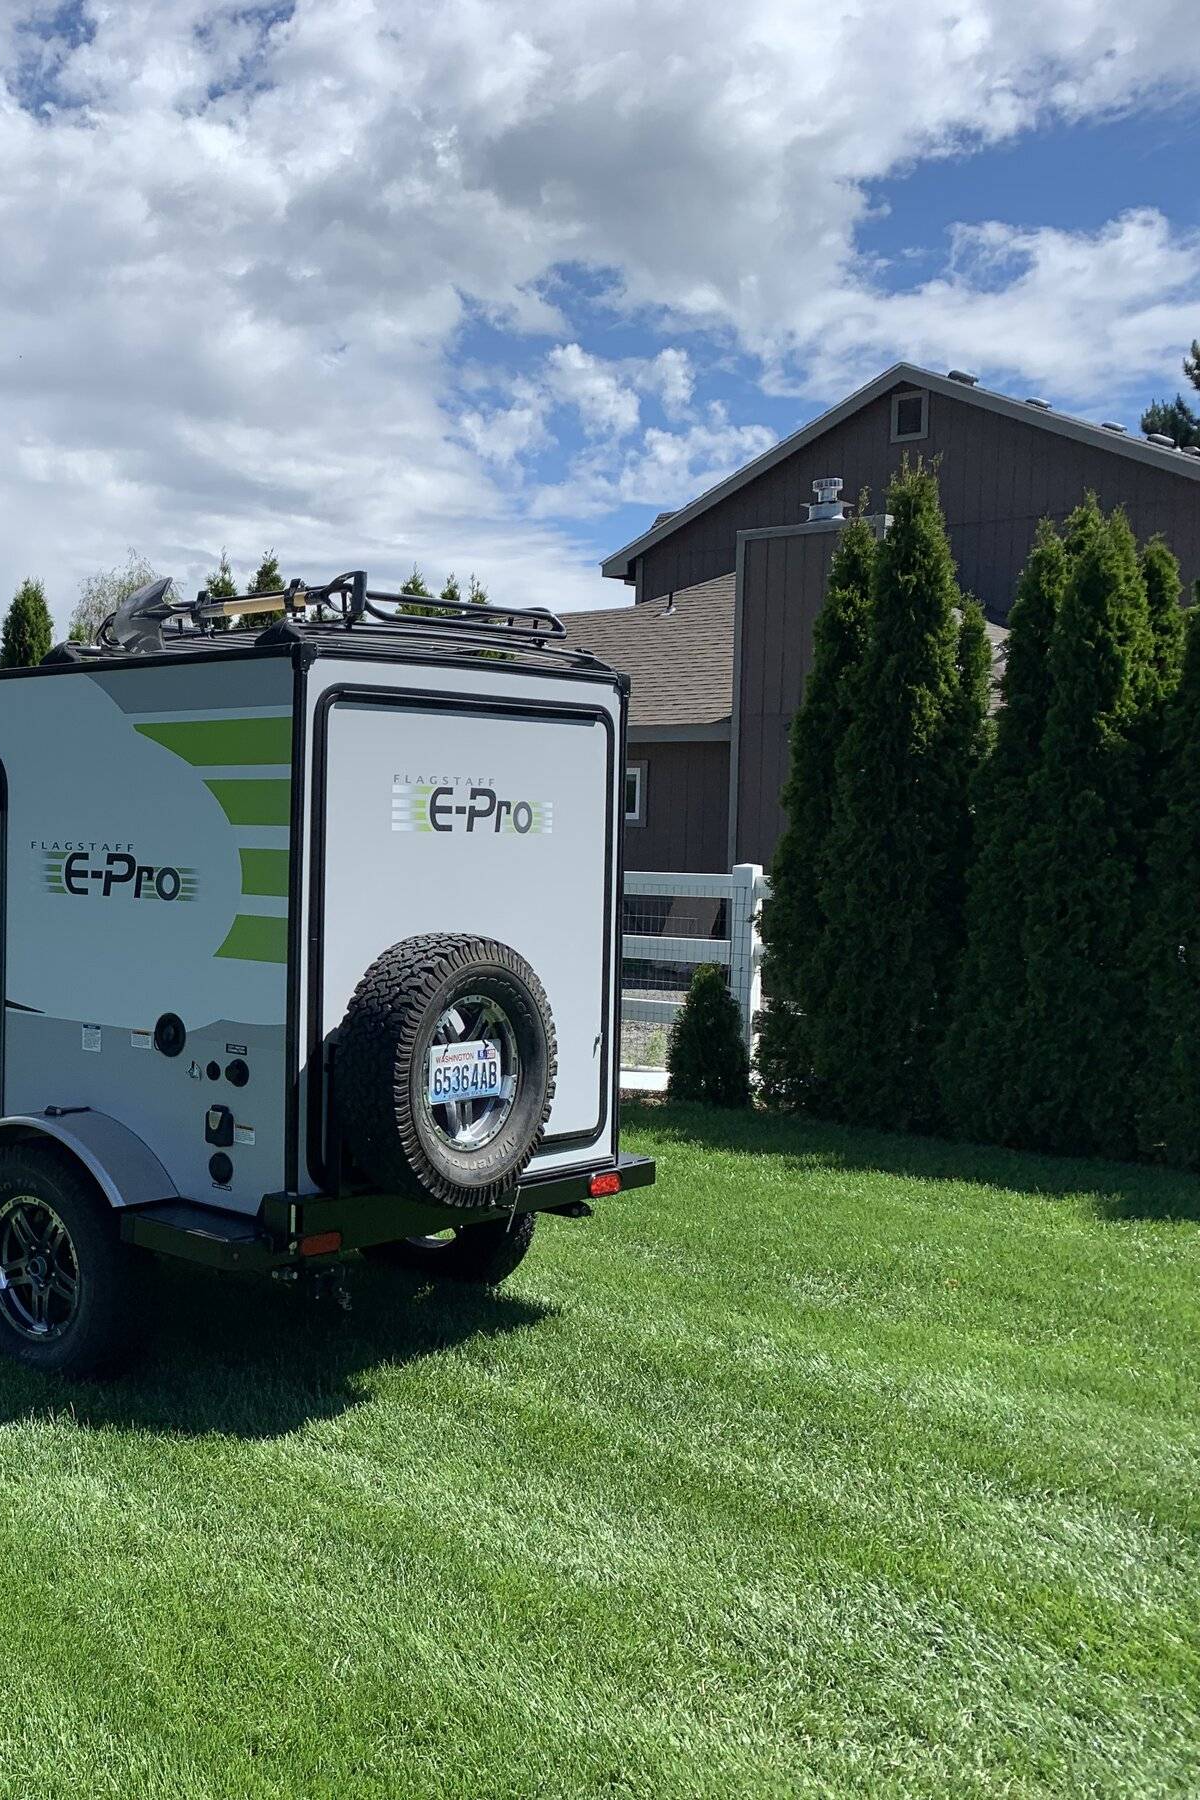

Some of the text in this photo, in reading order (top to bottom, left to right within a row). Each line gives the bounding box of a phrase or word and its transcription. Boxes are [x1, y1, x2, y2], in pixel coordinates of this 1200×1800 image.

[393, 774, 497, 787] FLAGSTAFF
[429, 786, 533, 834] E-Pro
[30, 841, 135, 853] FLAGSTAFF
[64, 852, 181, 901] E-Pro
[435, 1052, 475, 1063] WASHINGTON
[433, 1061, 497, 1096] 65364AB
